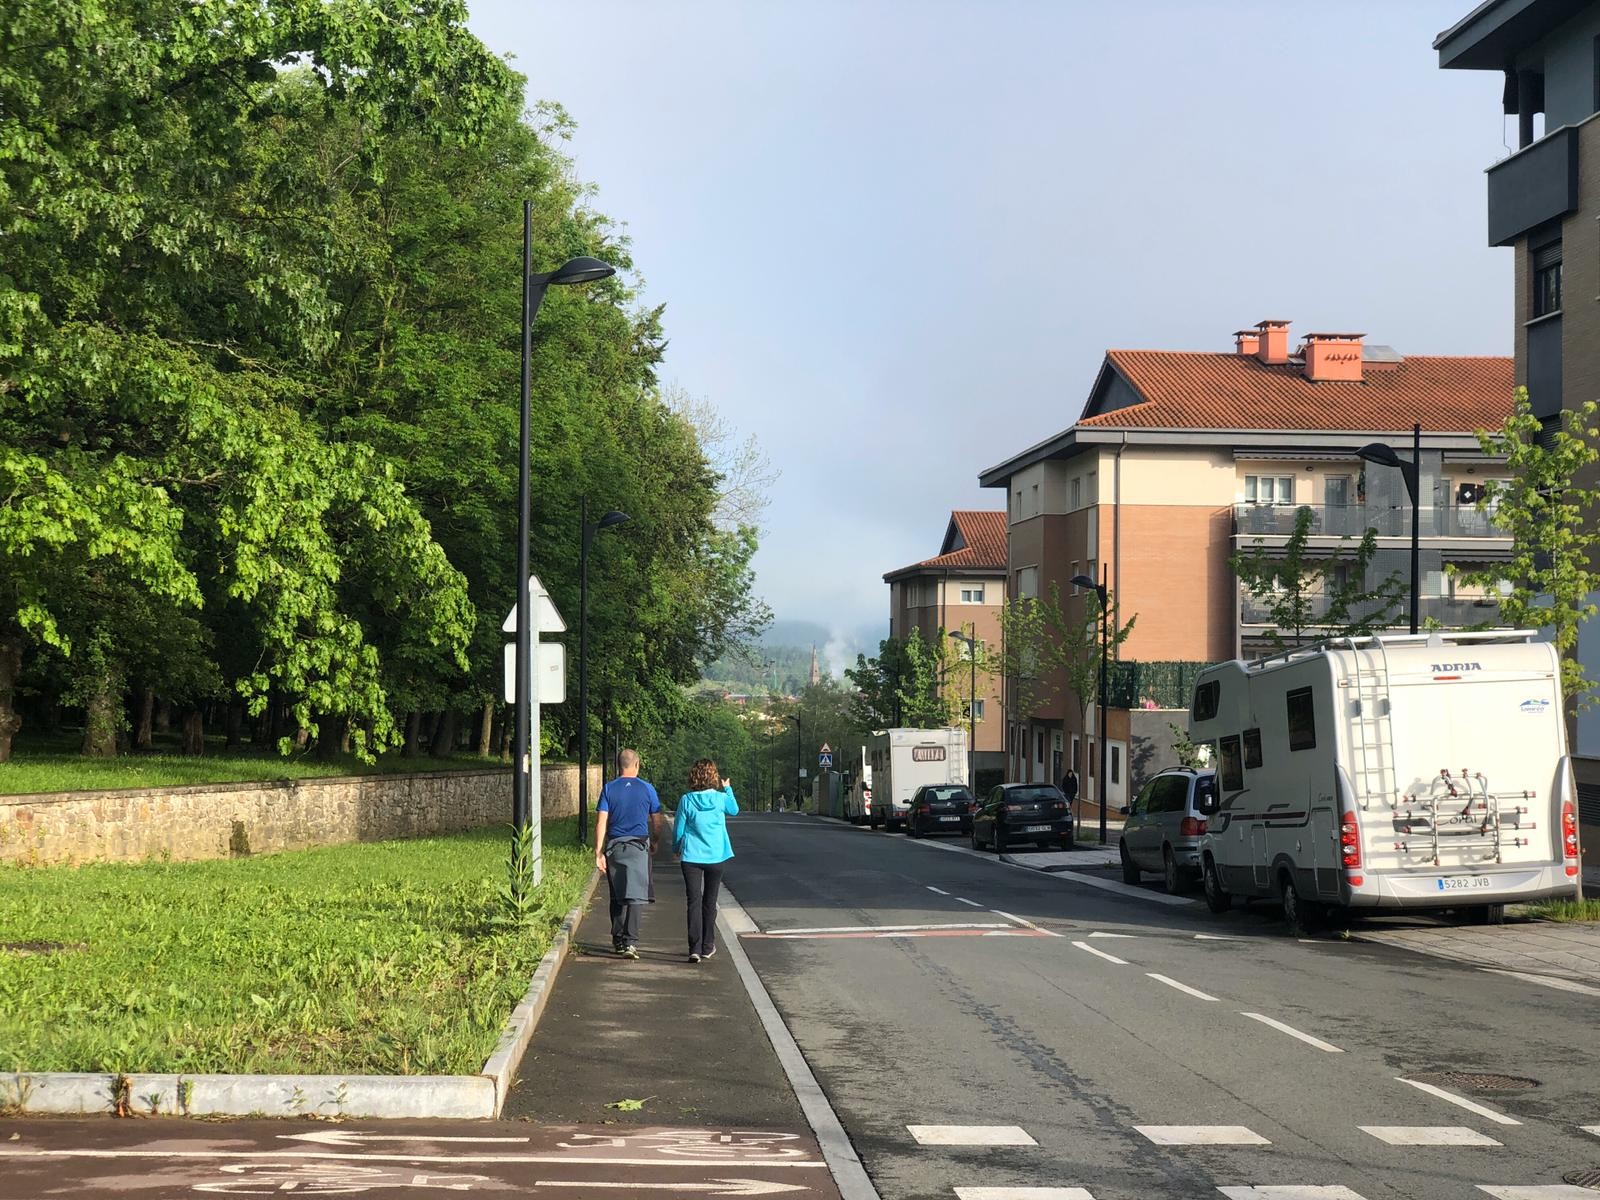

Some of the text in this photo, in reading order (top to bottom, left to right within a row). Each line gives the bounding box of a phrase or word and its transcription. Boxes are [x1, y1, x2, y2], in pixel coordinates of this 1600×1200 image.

[1431, 662, 1482, 672] ADRIA
[1444, 878, 1490, 889] 5282 JVB
